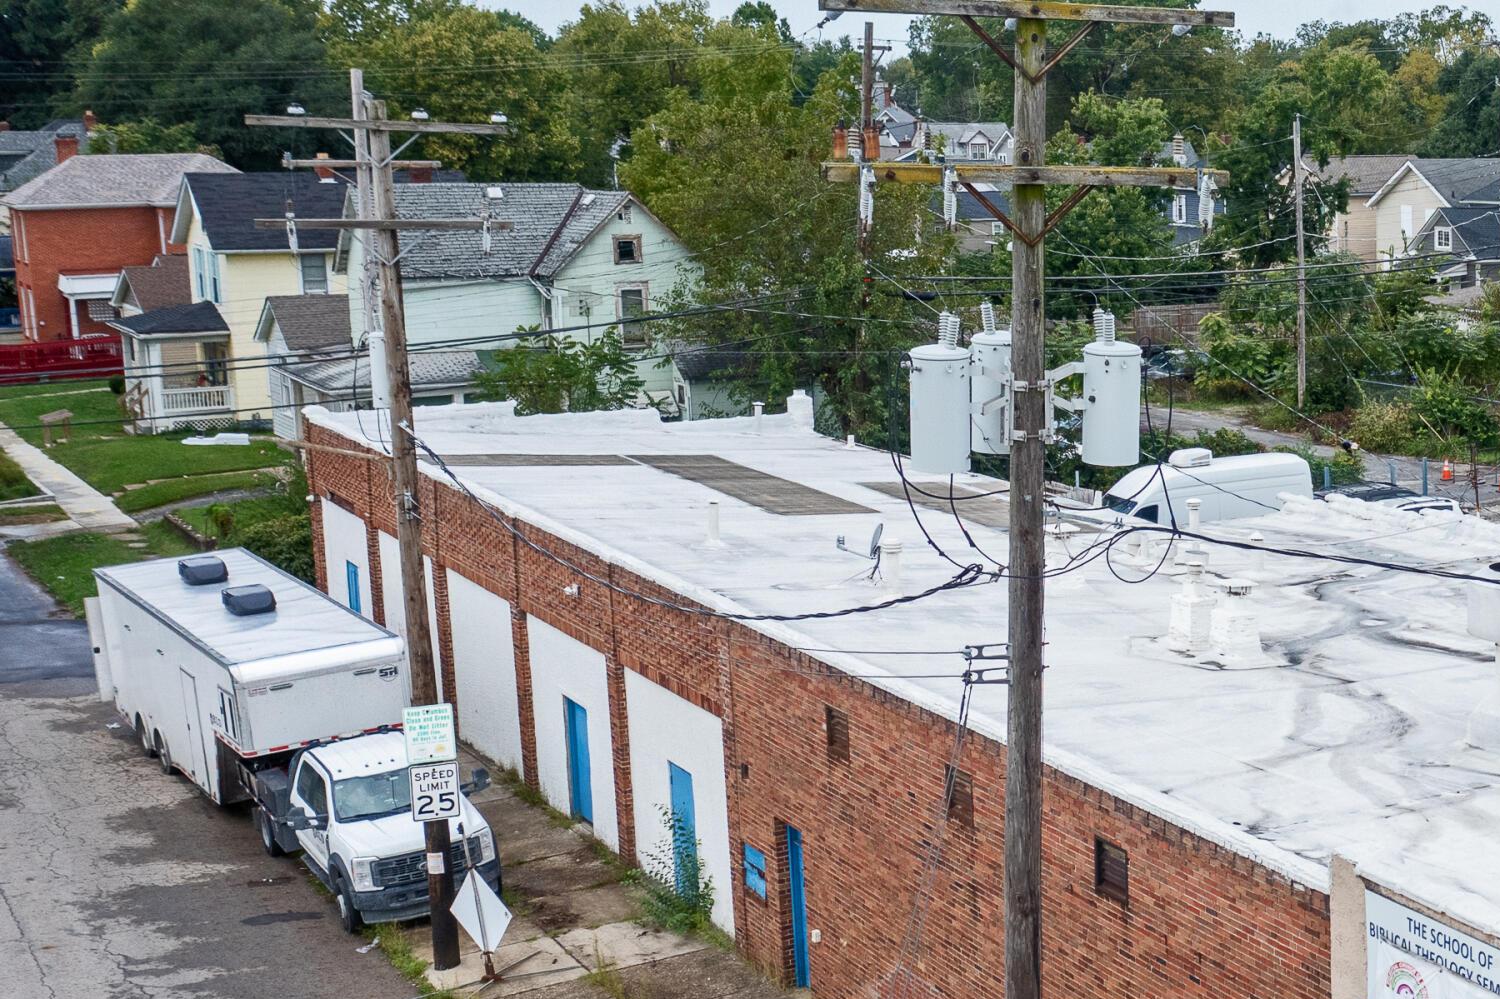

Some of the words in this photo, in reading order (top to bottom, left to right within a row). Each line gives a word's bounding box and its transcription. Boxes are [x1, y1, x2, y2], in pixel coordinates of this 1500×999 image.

[414, 769, 454, 782] SPEED
[419, 781, 450, 793] LIMIT
[417, 792, 455, 815] 25
[1369, 921, 1411, 952] BIBLICAL
[1415, 944, 1474, 980] THEOLOGY
[1407, 916, 1427, 940] THE
[1430, 928, 1475, 963] SCHOOL
[1478, 951, 1494, 970] OF
